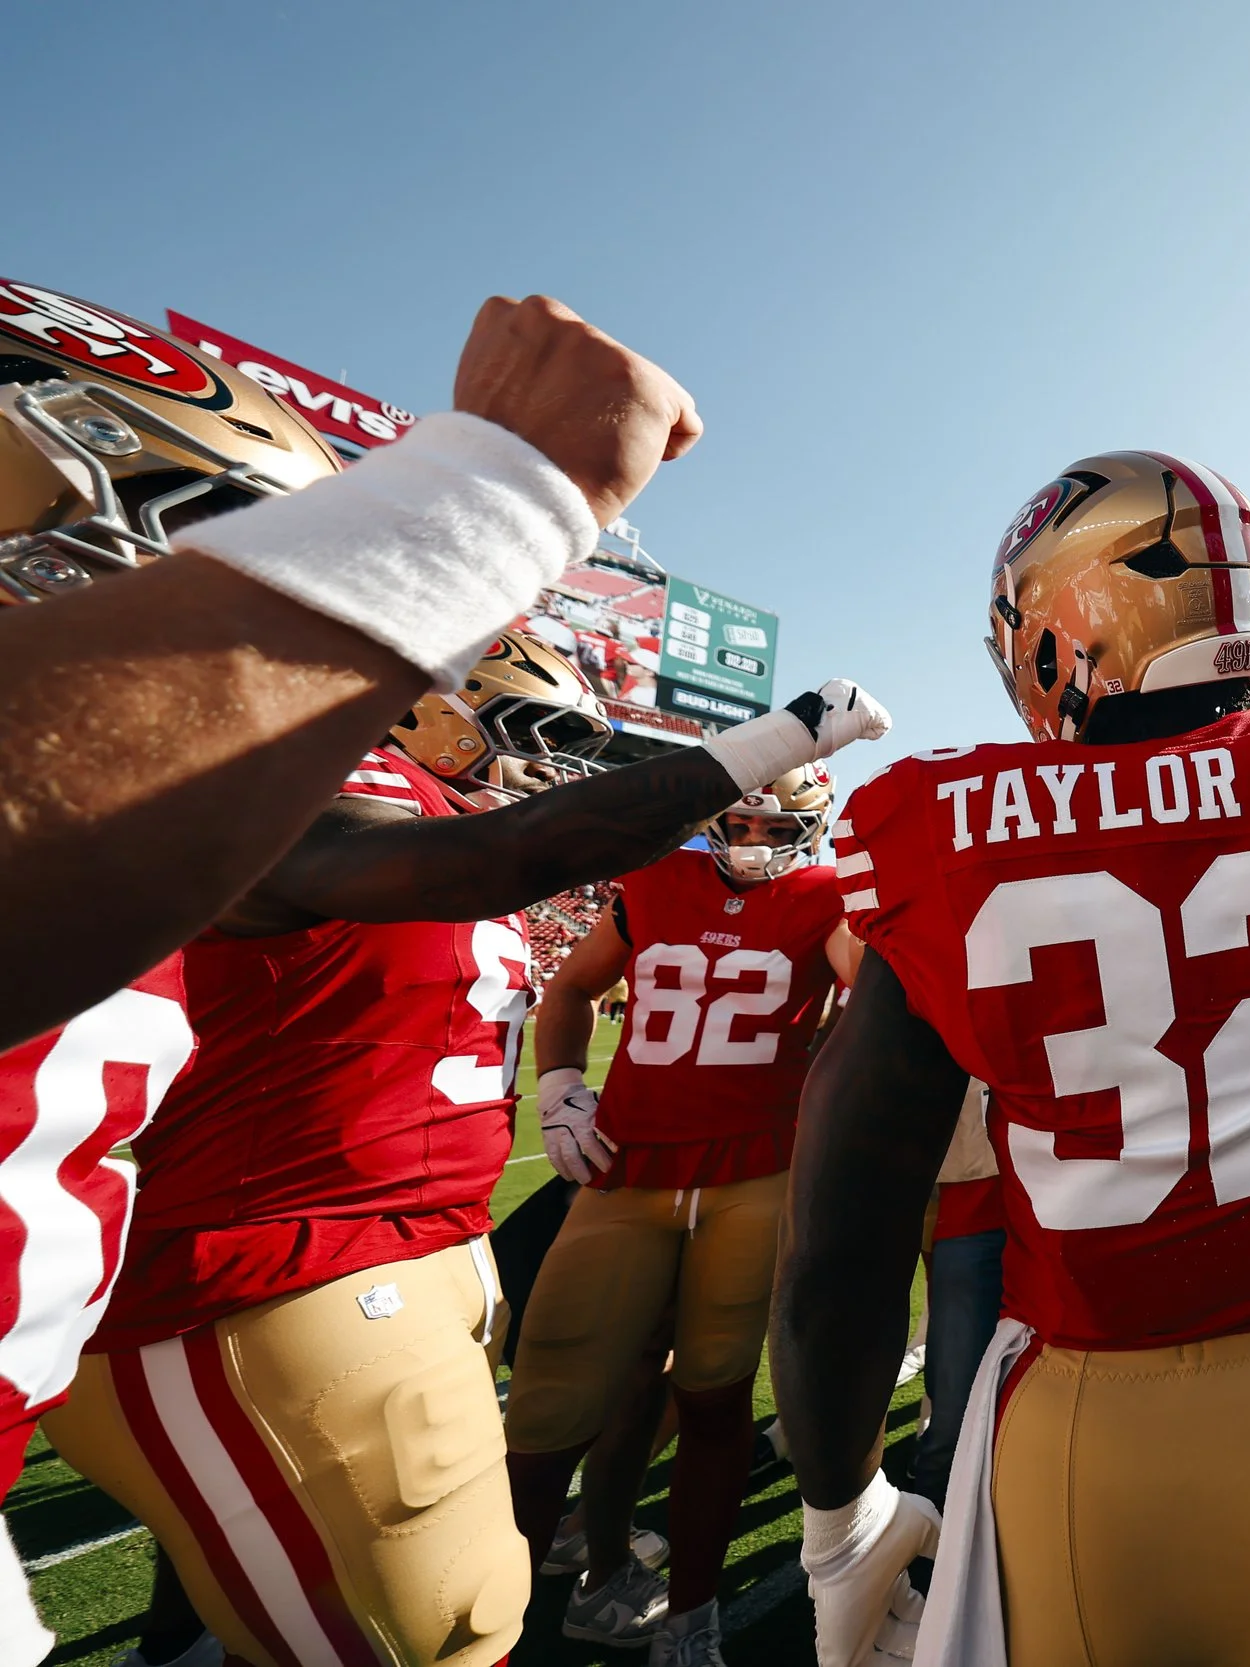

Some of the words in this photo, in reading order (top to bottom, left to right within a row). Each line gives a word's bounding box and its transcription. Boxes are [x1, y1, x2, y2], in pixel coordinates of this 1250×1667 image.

[675, 690, 710, 711] BUD
[709, 699, 753, 720] LIGHT
[1107, 680, 1122, 694] 32
[937, 746, 1243, 853] TAYLOR
[626, 942, 793, 1066] 82
